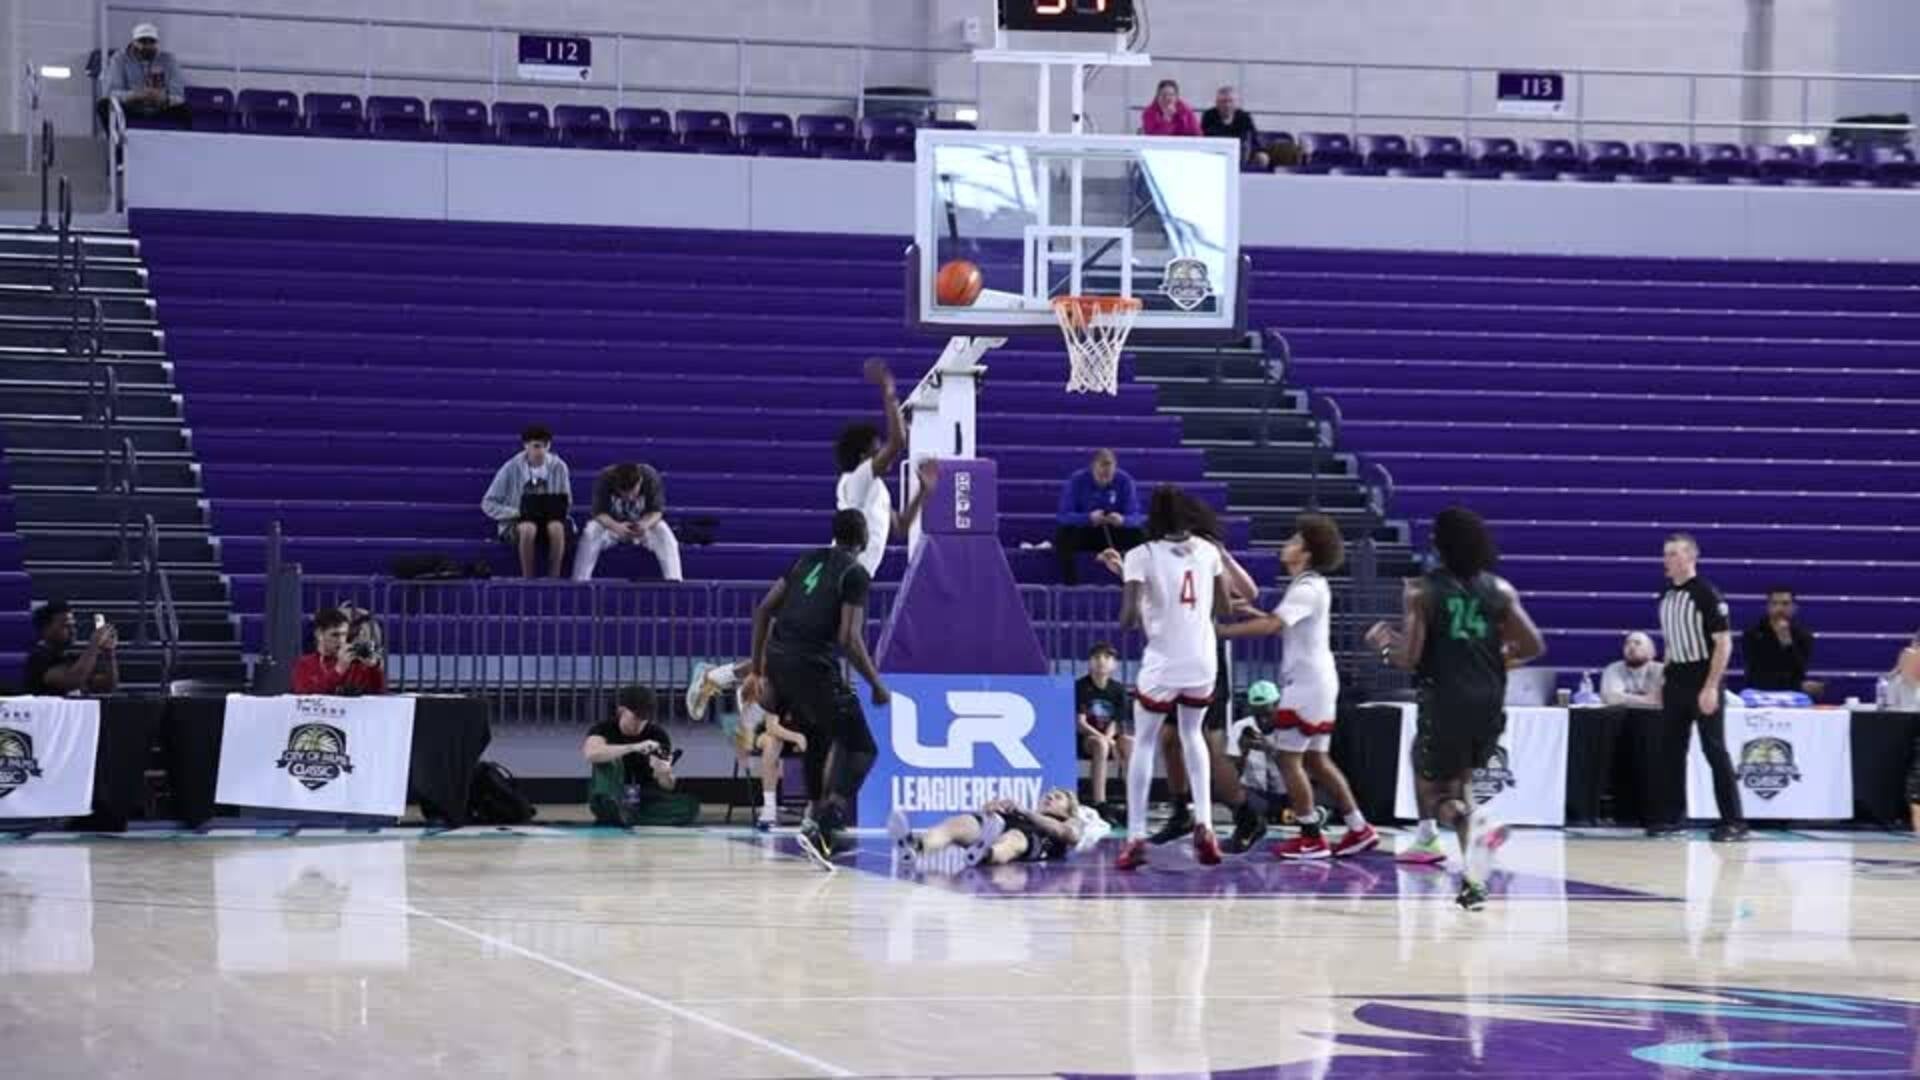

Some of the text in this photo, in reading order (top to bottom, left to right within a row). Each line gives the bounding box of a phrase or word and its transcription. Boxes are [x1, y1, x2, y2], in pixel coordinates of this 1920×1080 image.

[545, 41, 578, 61] 112
[1521, 78, 1553, 97] 113
[803, 562, 824, 595] 4
[1180, 569, 1197, 611] 4
[1447, 596, 1487, 640] 24
[292, 762, 335, 777] CLASSIC
